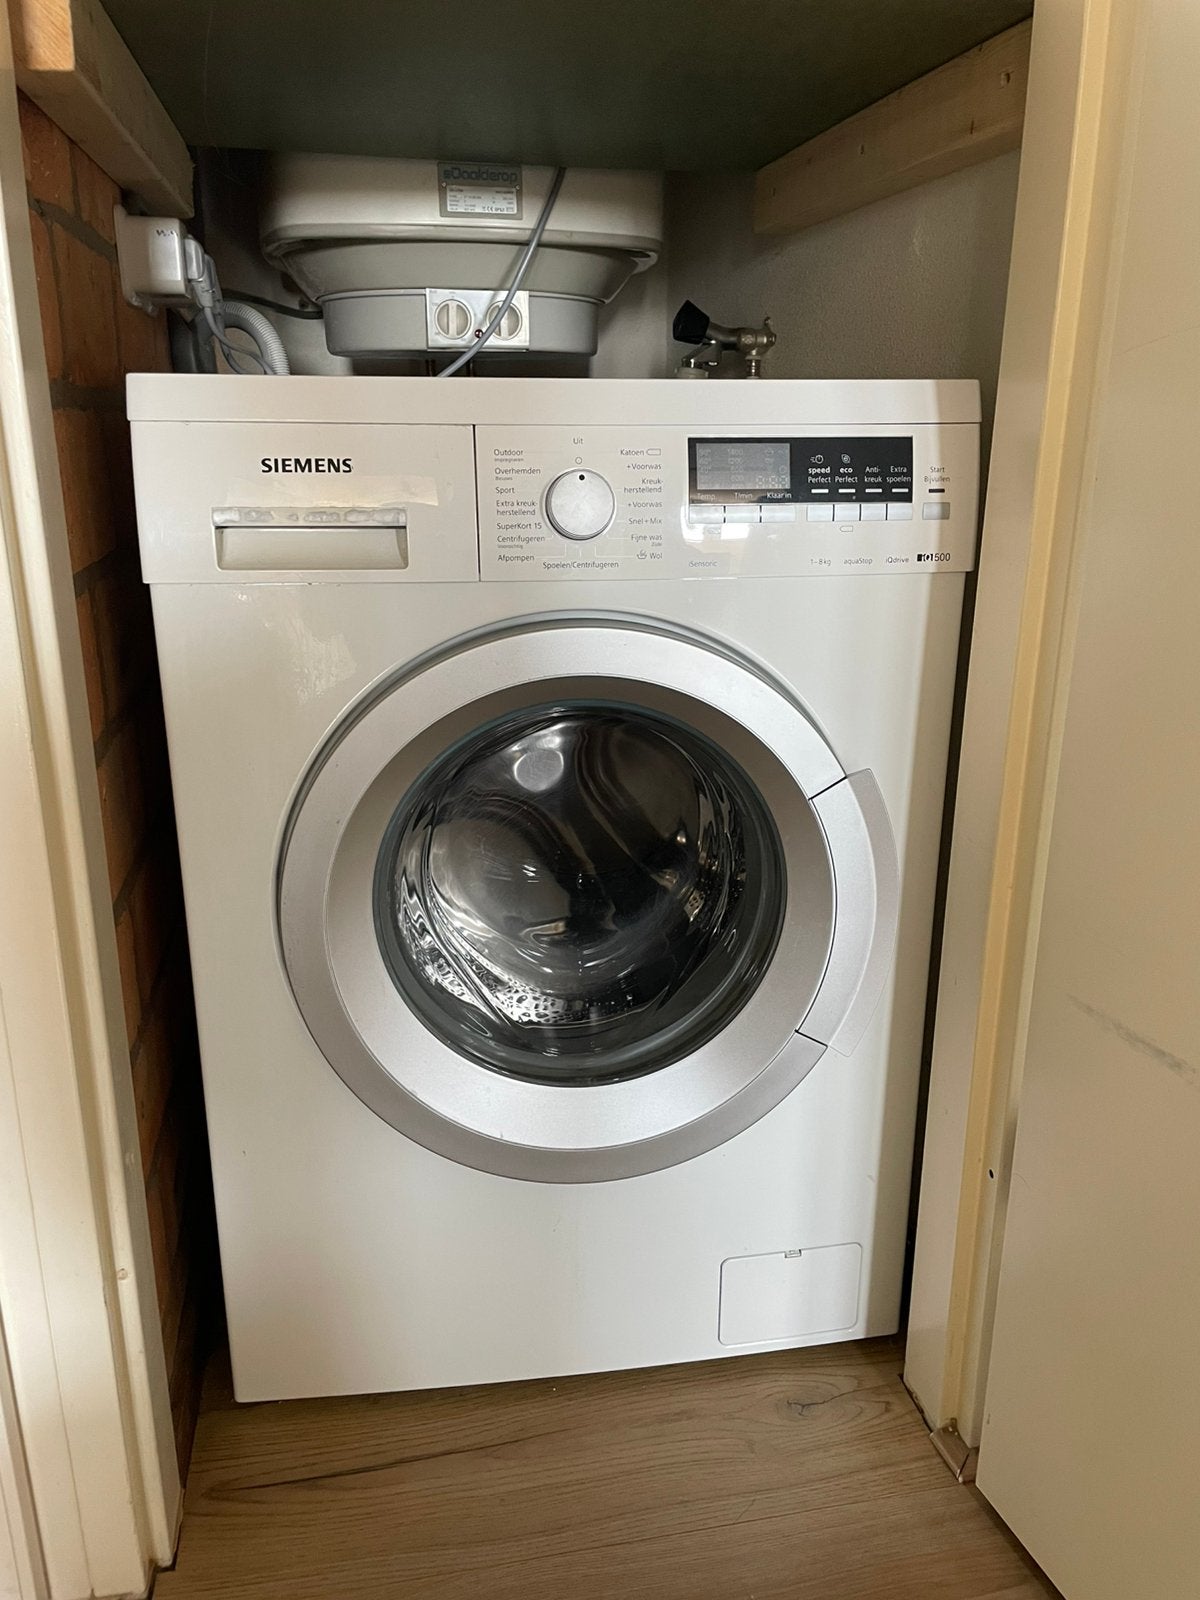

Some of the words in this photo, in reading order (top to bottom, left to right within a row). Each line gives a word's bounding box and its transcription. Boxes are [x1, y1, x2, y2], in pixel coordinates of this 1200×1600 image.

[573, 437, 583, 445] Uit
[493, 448, 524, 456] Outdoor
[620, 448, 644, 456] Katoen
[260, 457, 353, 474] SIEMENS
[865, 465, 880, 473] Anti-
[890, 465, 907, 473] Extra
[930, 465, 945, 473] Start
[494, 467, 541, 475] Overhemden
[808, 466, 831, 475] speed
[641, 477, 663, 485] Kreuk-
[808, 475, 831, 483] Perfect
[835, 475, 858, 483] Perfect
[864, 475, 882, 483] kreuk
[886, 475, 911, 483] spoelen
[495, 486, 515, 495] Sport
[623, 486, 662, 494] herstellend
[496, 499, 514, 507] Extra
[516, 499, 538, 507] kreuk-
[496, 522, 532, 531] SuperKort
[535, 522, 542, 530] 15
[497, 535, 545, 544] Centrifugeren
[497, 554, 535, 563] Afpompen
[649, 552, 663, 560] Wol
[886, 556, 909, 564] iQdrive
[542, 561, 620, 570] Spoelen/Centrifugeren
[843, 557, 873, 566] aquaStop
